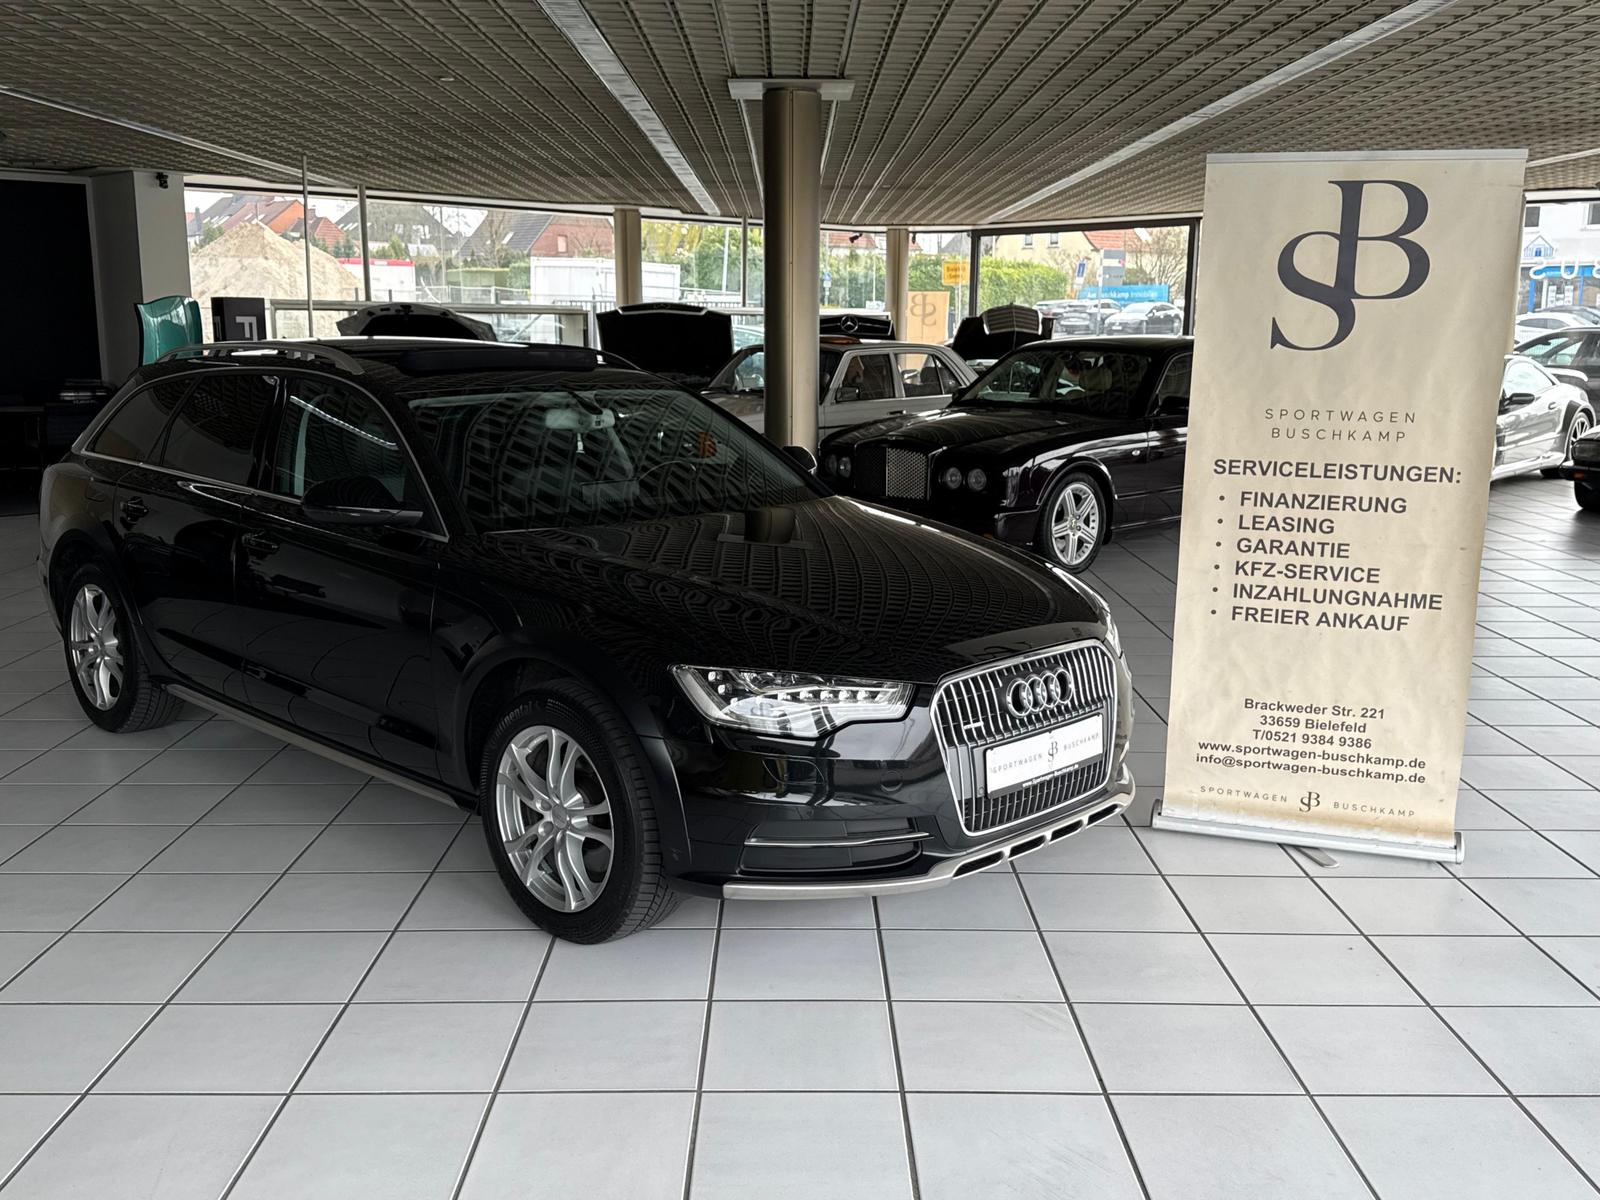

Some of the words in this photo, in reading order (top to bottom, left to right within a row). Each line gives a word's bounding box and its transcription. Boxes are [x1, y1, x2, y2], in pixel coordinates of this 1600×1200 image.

[1265, 408, 1415, 423] SPORTWAGEN
[1272, 428, 1405, 442] BUSCHKAMP
[1213, 459, 1461, 483] SERVICELEISTUNGEN:
[1240, 491, 1407, 514] FINANZIERUNG
[1238, 514, 1334, 534] LEASING
[1237, 537, 1350, 559] GARANTIE
[1235, 560, 1380, 583] KFZ-SERVICE
[1233, 583, 1443, 610] INZAHLUNGNAHME
[1232, 606, 1309, 626] FREIER
[1315, 612, 1409, 631] ANKAUF
[1244, 698, 1328, 715] Brackweder
[1332, 705, 1355, 717] Str.
[1360, 707, 1384, 719] 221
[1260, 715, 1300, 728] 33659
[1305, 719, 1366, 733] Bielefeld
[1252, 729, 1296, 743] T/0521
[1302, 733, 1334, 746] 9384
[1339, 736, 1372, 749] 9386
[1198, 742, 1426, 769] www.sportwagen-buschkamp.de
[1196, 753, 1425, 783] info@sportwagen-buschkamp.de
[1200, 786, 1287, 802] SPORTWAGEN
[1333, 802, 1415, 816] BUSCHKAMP
